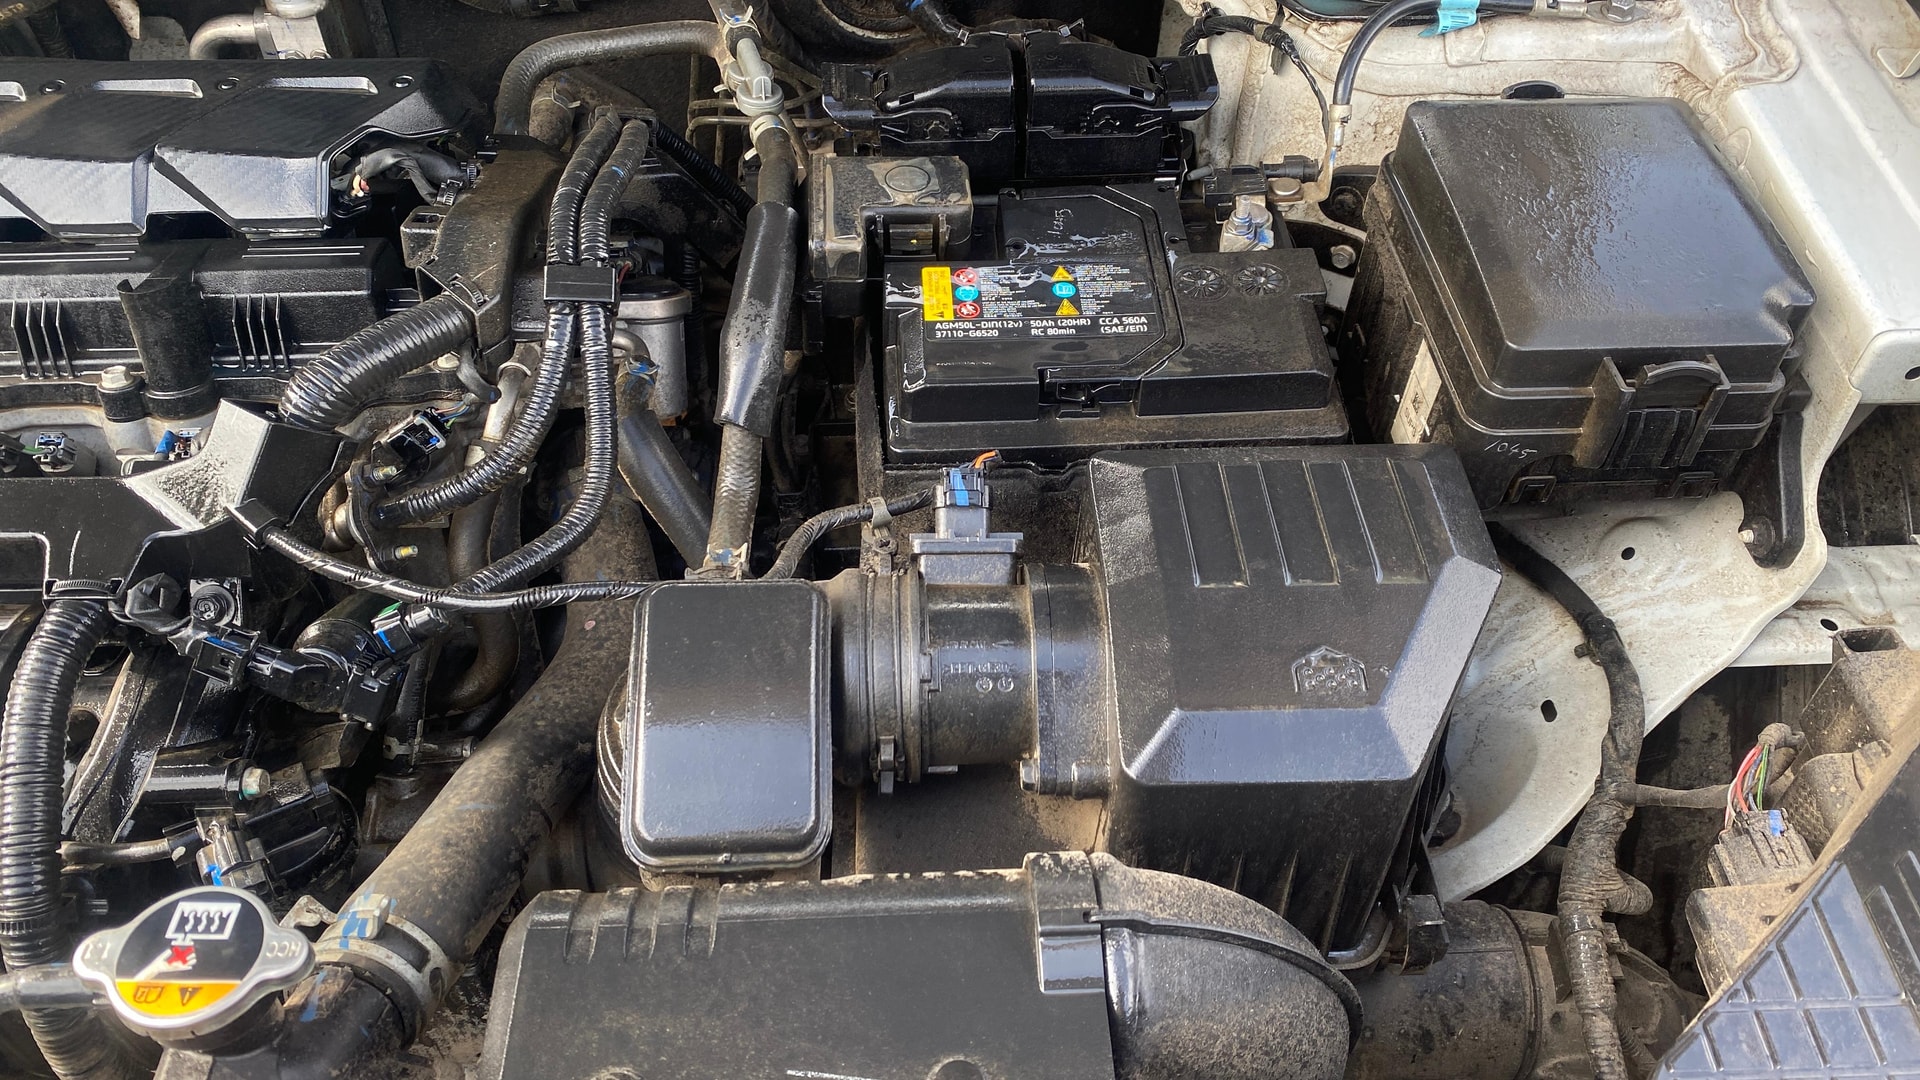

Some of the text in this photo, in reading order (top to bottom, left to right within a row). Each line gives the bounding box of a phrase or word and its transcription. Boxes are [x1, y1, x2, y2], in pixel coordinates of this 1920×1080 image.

[1030, 318, 1091, 328] 50Ah (20HR)
[1099, 316, 1148, 325] CCA 560A
[935, 329, 999, 338] 37110-G6520
[1031, 327, 1076, 336] RC 80min
[1484, 439, 1538, 459] 1045
[265, 940, 302, 958] HCC
